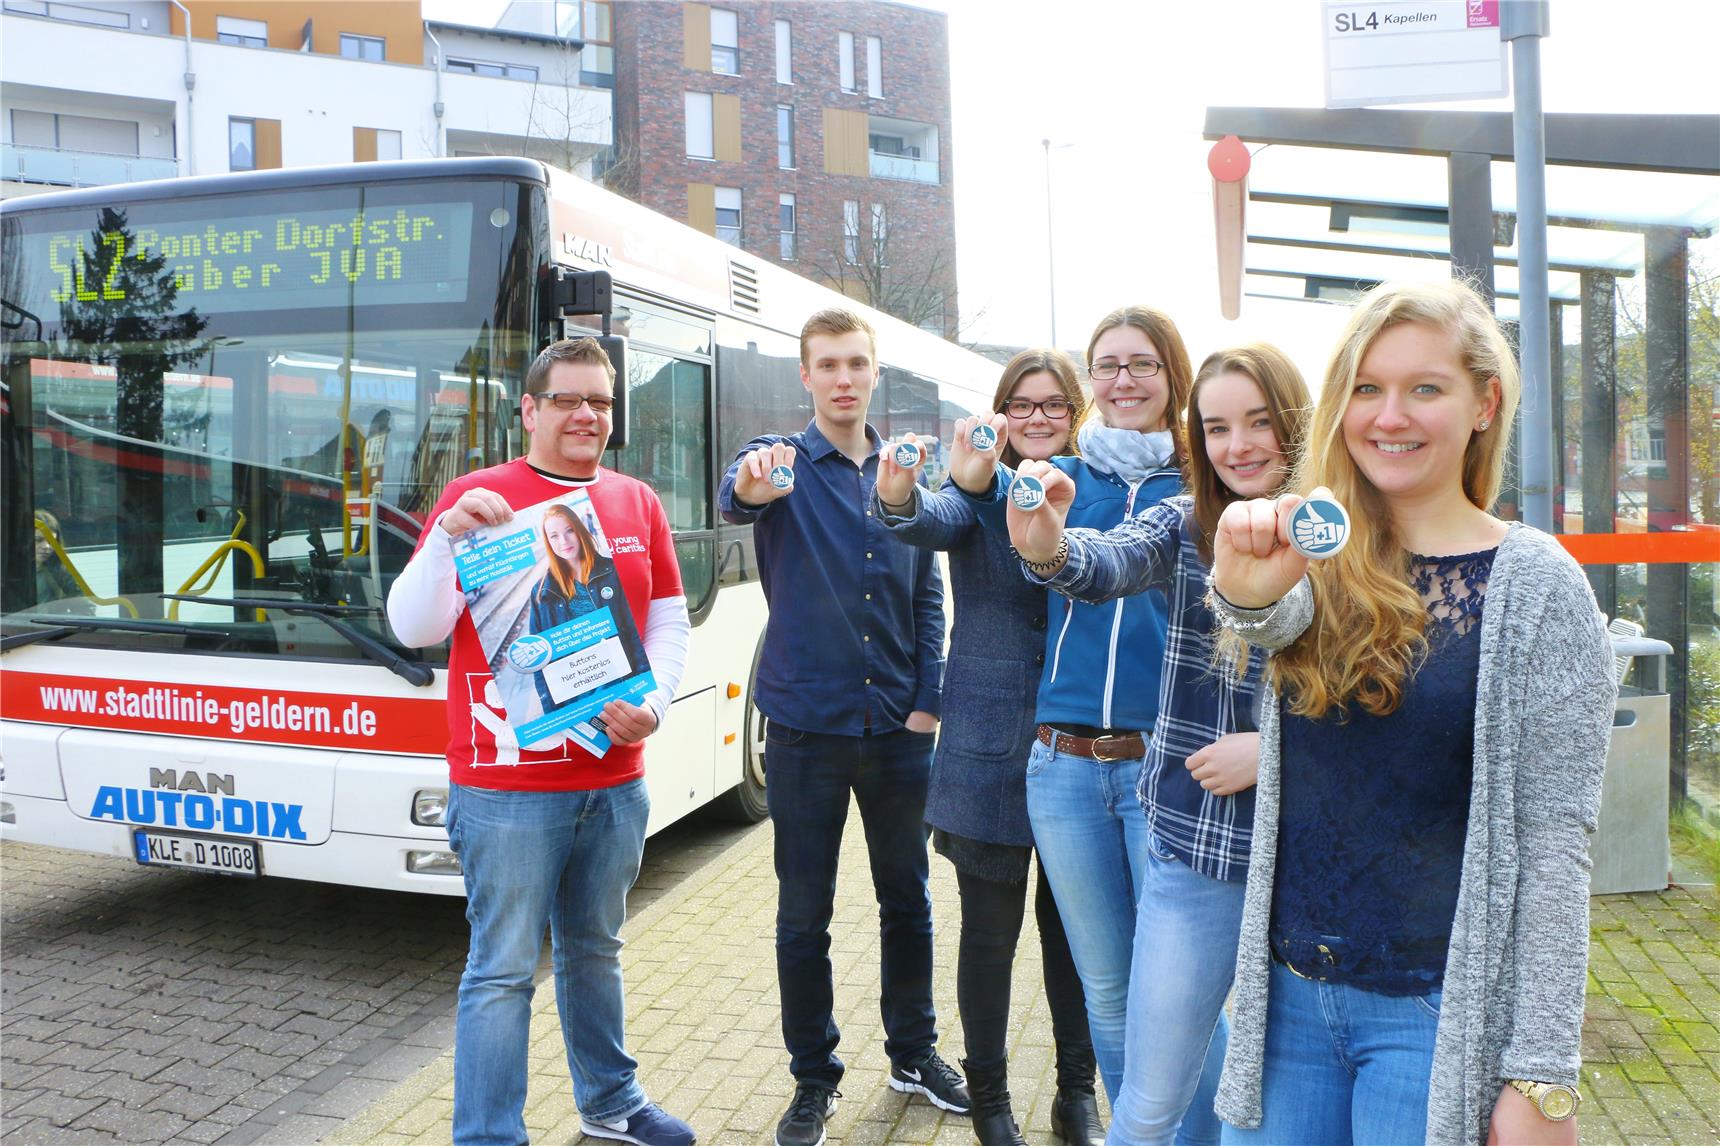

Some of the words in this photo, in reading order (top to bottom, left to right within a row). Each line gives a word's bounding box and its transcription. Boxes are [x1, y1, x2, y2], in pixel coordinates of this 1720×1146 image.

[1335, 12, 1379, 32] SL4
[1384, 13, 1437, 25] Kapellen
[136, 225, 263, 261] Ponter
[276, 209, 443, 251] Dorfstr.
[48, 230, 126, 303] SL2
[174, 260, 281, 293] über
[309, 246, 402, 284] JVA
[612, 536, 640, 547] young
[1317, 526, 1333, 541] +1
[461, 552, 481, 565] Teile
[482, 545, 502, 557] dein
[502, 533, 531, 549] Ticket
[616, 544, 646, 554] caritas
[561, 672, 576, 683] hier
[577, 658, 612, 675] kostenlos
[569, 653, 598, 668] Buttons
[573, 670, 608, 688] erhältlich
[40, 686, 377, 736] www.stadtlinie-geldern.de
[150, 767, 235, 796] MAN
[148, 837, 182, 862] KLE
